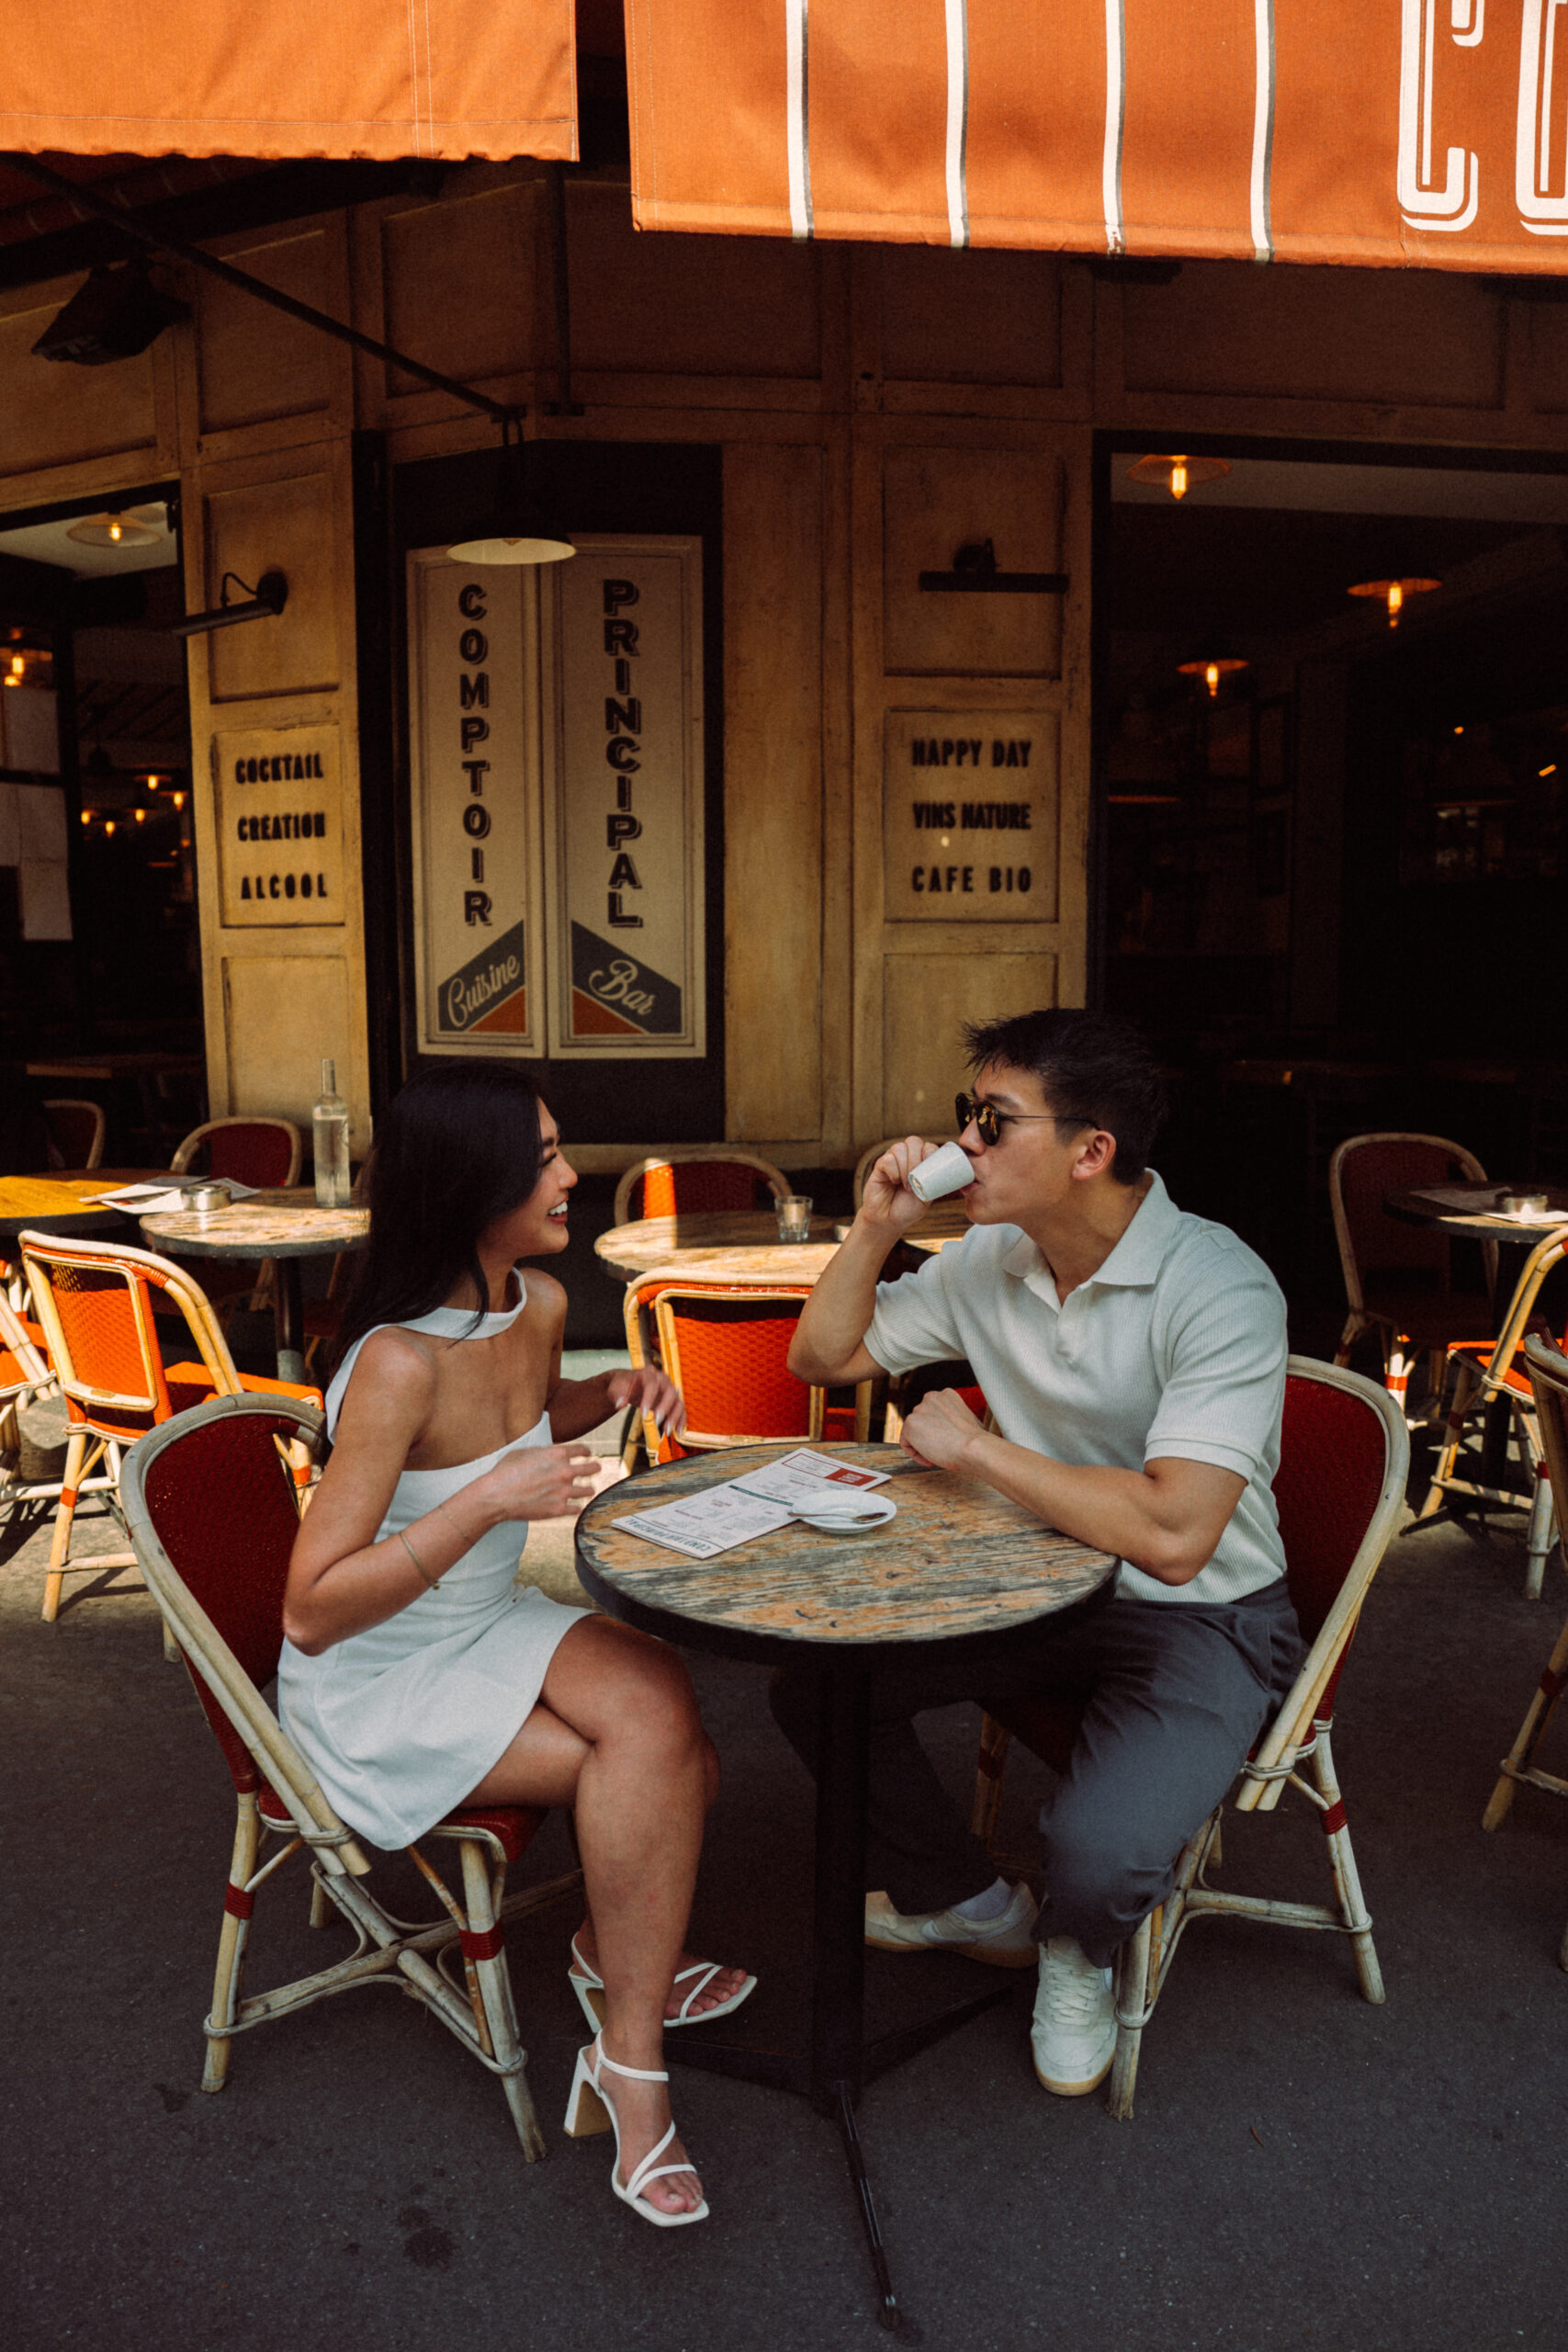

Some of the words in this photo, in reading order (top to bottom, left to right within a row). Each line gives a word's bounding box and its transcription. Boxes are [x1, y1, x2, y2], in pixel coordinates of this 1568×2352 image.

[235, 752, 323, 784] COCKTAIL
[458, 583, 491, 926] COMPTOIR
[604, 579, 643, 928] PRINCIPAL
[912, 739, 982, 766] HAPPY
[992, 740, 1032, 767] DAY
[237, 812, 325, 842] CREATION
[912, 803, 955, 829] VINS
[961, 803, 1032, 830] NATURE
[241, 874, 327, 899] ALCOOL
[912, 866, 974, 892] CAFE
[989, 866, 1031, 892] BIO
[447, 955, 521, 1028] Cuisine
[589, 959, 656, 1015] Bar
